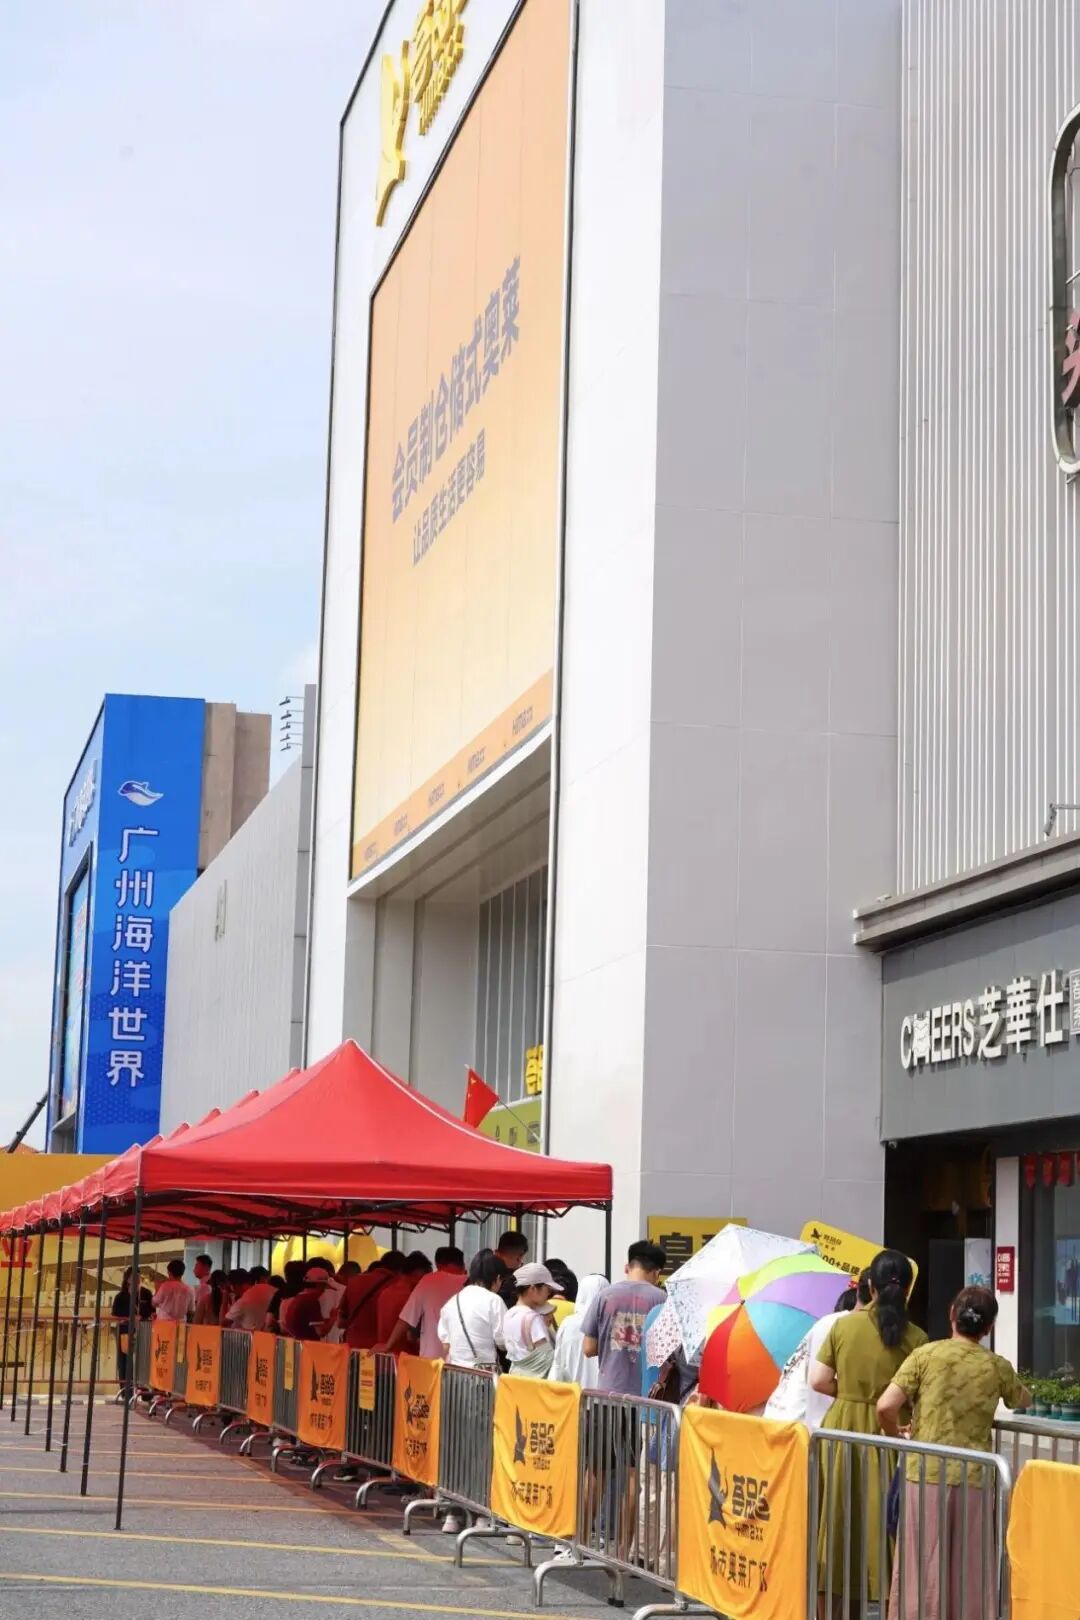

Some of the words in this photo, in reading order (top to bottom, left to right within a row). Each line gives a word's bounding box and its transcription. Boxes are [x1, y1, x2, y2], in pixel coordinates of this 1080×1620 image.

[391, 255, 521, 524] 会员制仓储式奥莱
[105, 826, 160, 1088] 广州海洋世界
